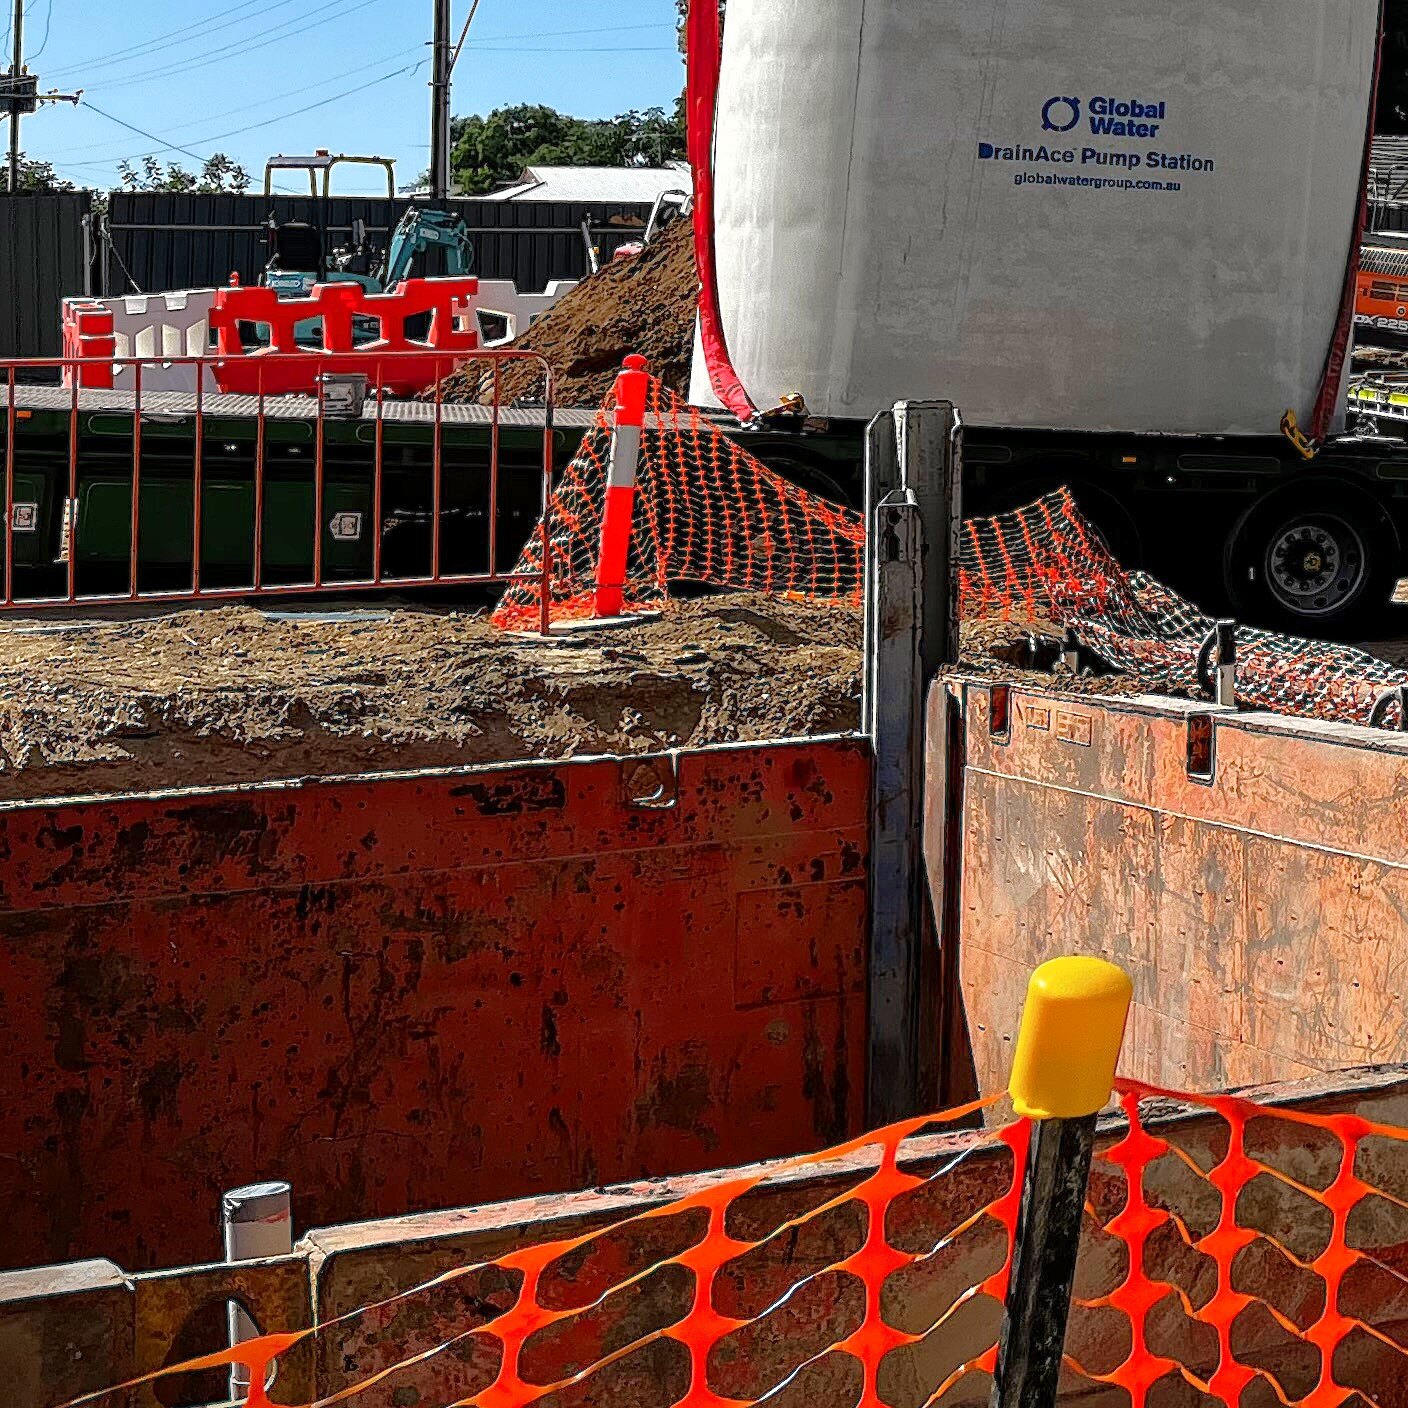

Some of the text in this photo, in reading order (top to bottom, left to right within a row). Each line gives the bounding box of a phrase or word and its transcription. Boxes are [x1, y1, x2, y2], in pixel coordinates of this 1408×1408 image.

[1088, 96, 1166, 120] Global
[1088, 116, 1160, 138] Water
[977, 142, 1215, 172] DrainAce Pump Station
[1014, 172, 1181, 192] globalwatergroup.com.au
